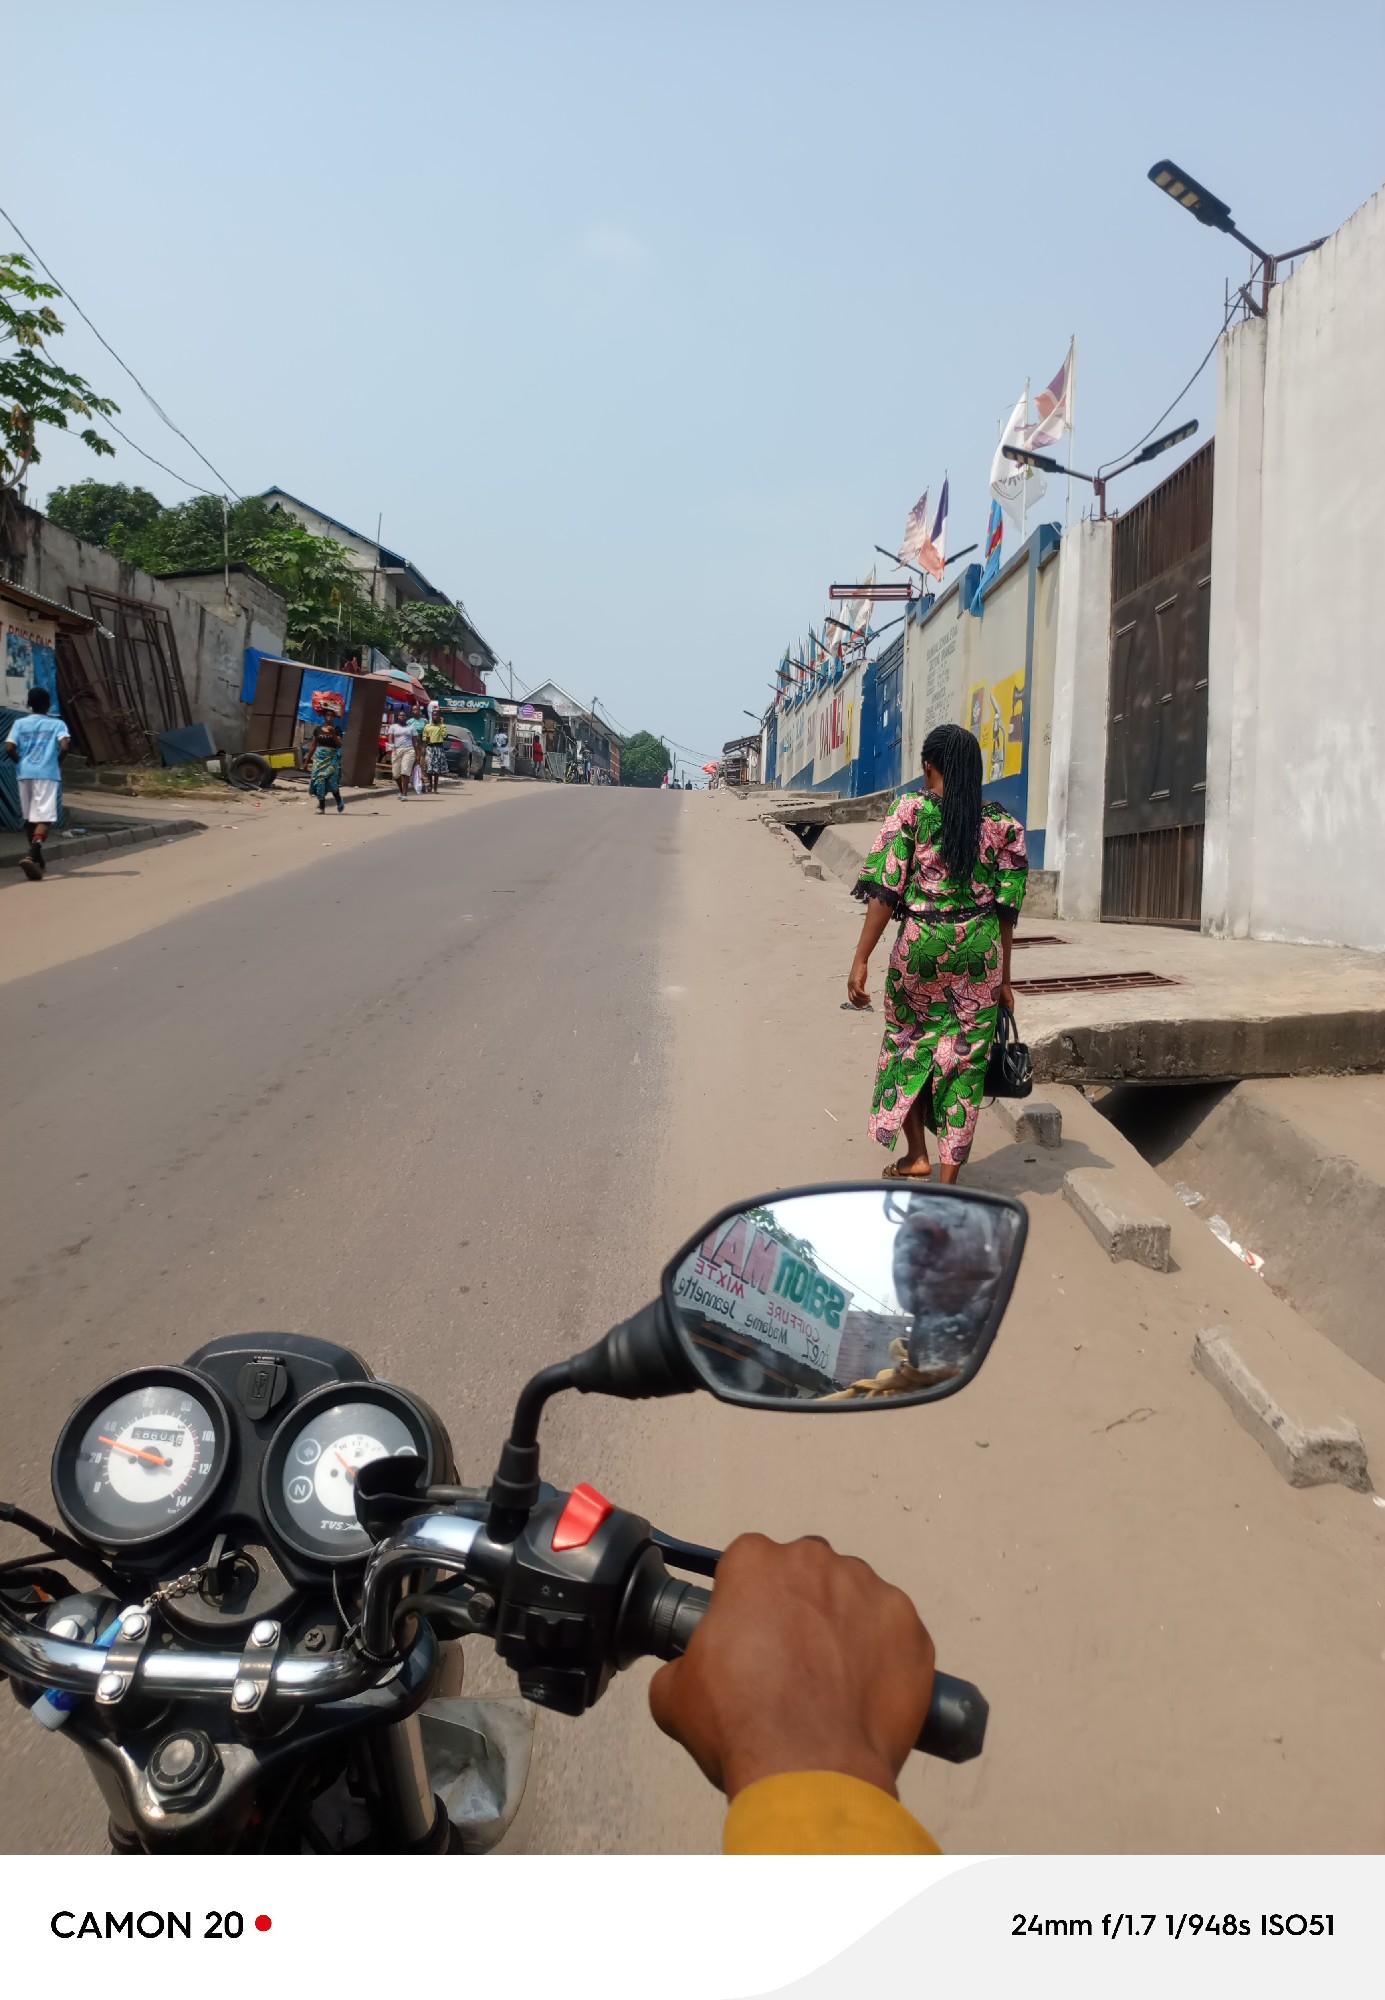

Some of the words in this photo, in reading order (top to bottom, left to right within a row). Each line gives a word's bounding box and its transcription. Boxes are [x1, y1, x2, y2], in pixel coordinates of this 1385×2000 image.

[89, 1452, 103, 1464] 20
[199, 1463, 212, 1475] 12
[294, 1483, 306, 1497] N
[320, 1520, 344, 1531] TVS
